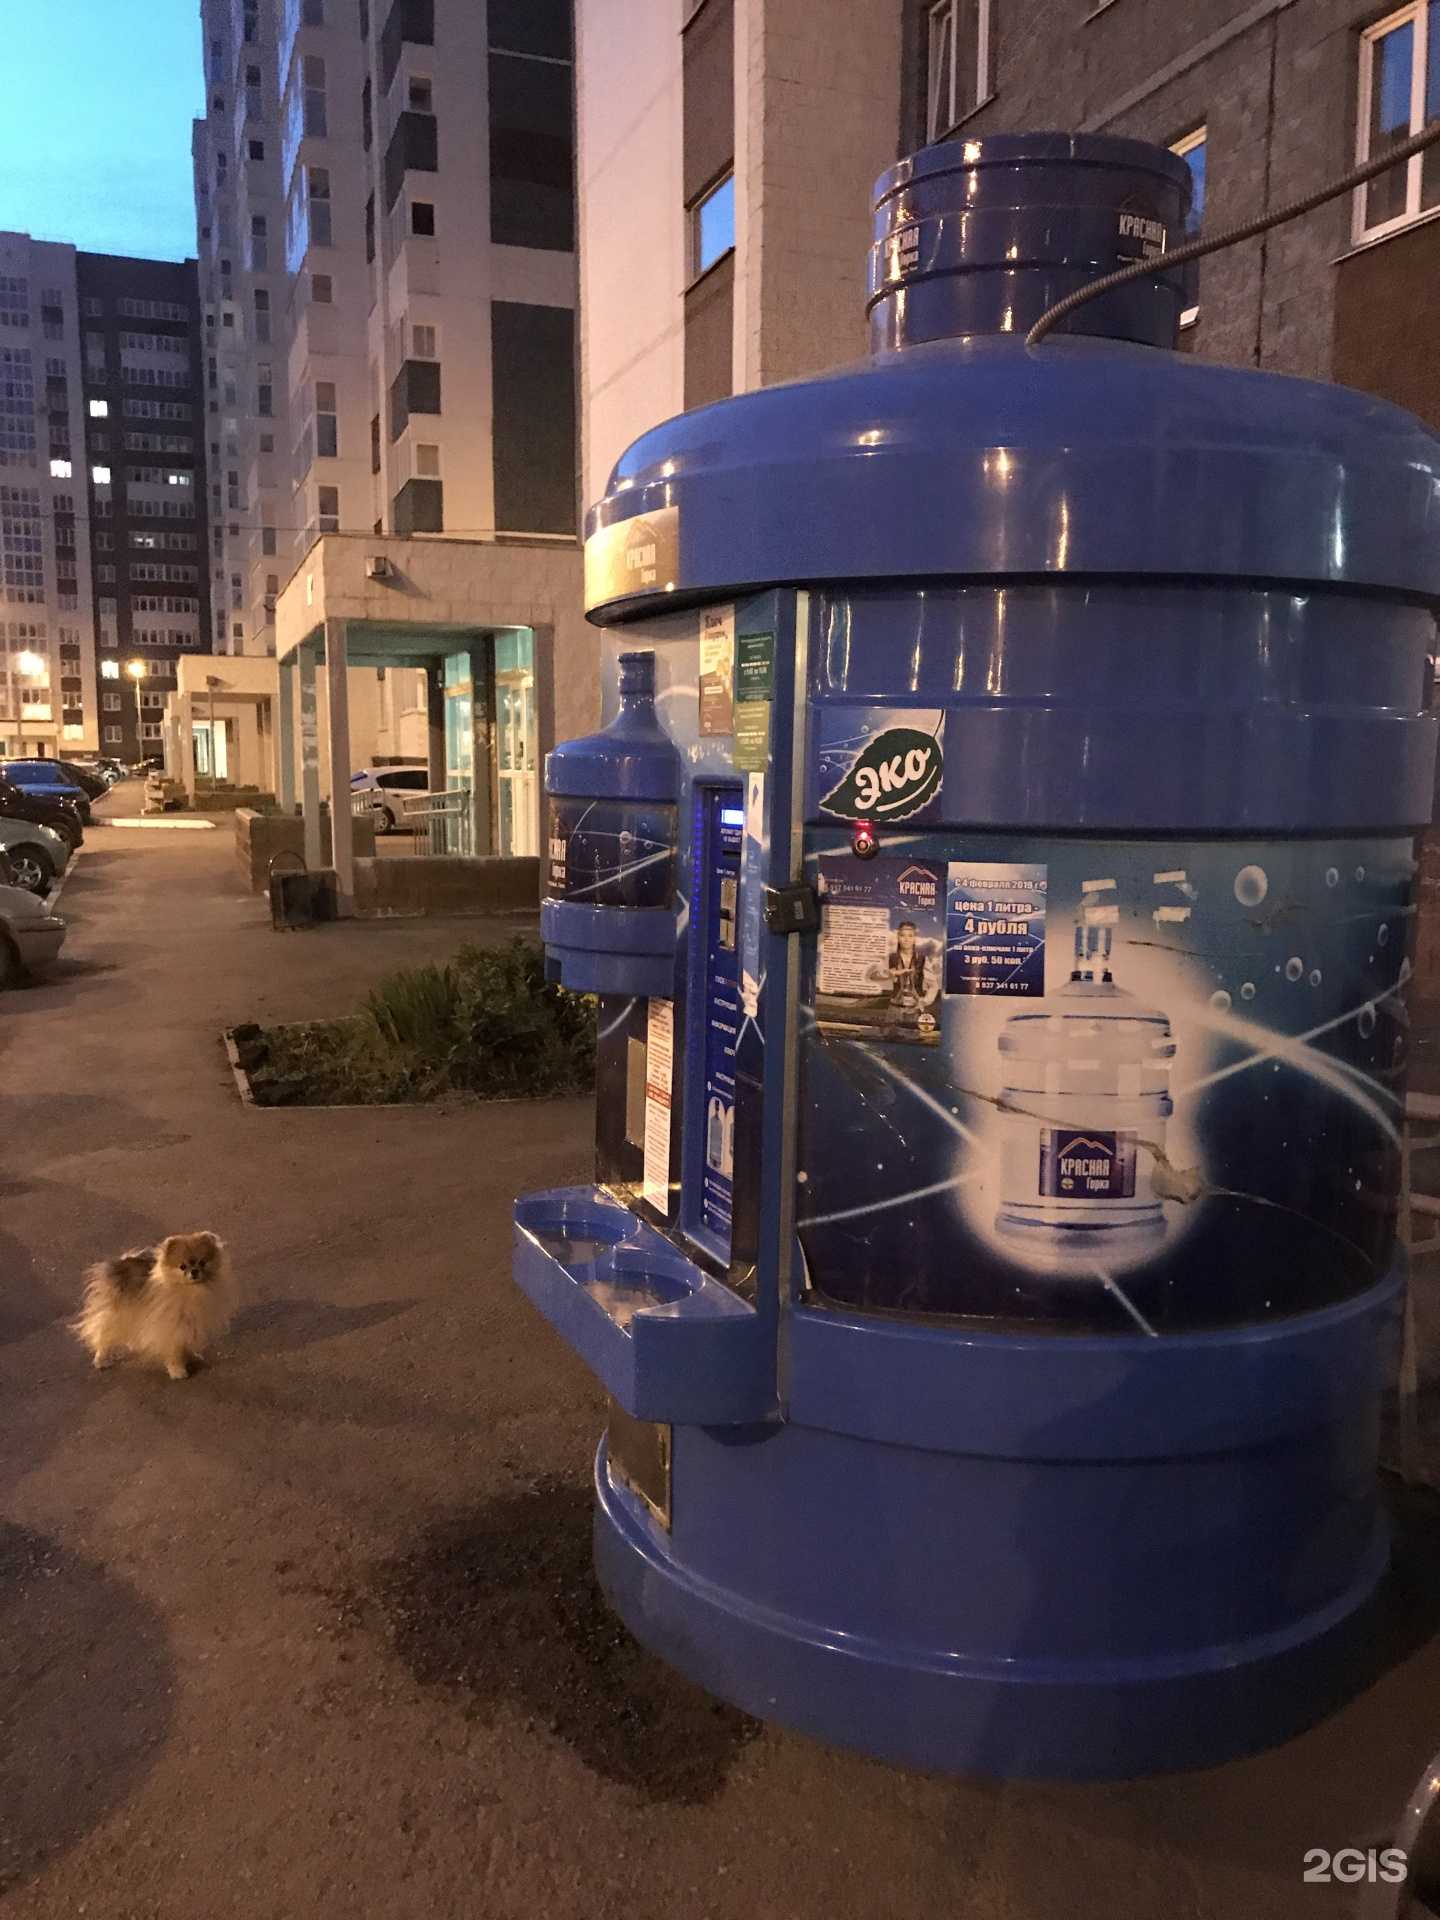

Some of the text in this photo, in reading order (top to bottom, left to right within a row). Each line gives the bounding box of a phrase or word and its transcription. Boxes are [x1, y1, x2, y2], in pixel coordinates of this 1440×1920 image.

[899, 881, 936, 896] КРАСНАЯ
[1012, 880, 1033, 890] 2019
[954, 901, 985, 912] цена
[987, 901, 993, 912] 1
[994, 902, 1032, 914] литра
[964, 918, 1028, 935] 4 рубля
[964, 955, 970, 964] 3
[991, 956, 1003, 965] 50
[1060, 1158, 1110, 1176] КРАСНАЯ
[1086, 1177, 1110, 1192] Горка
